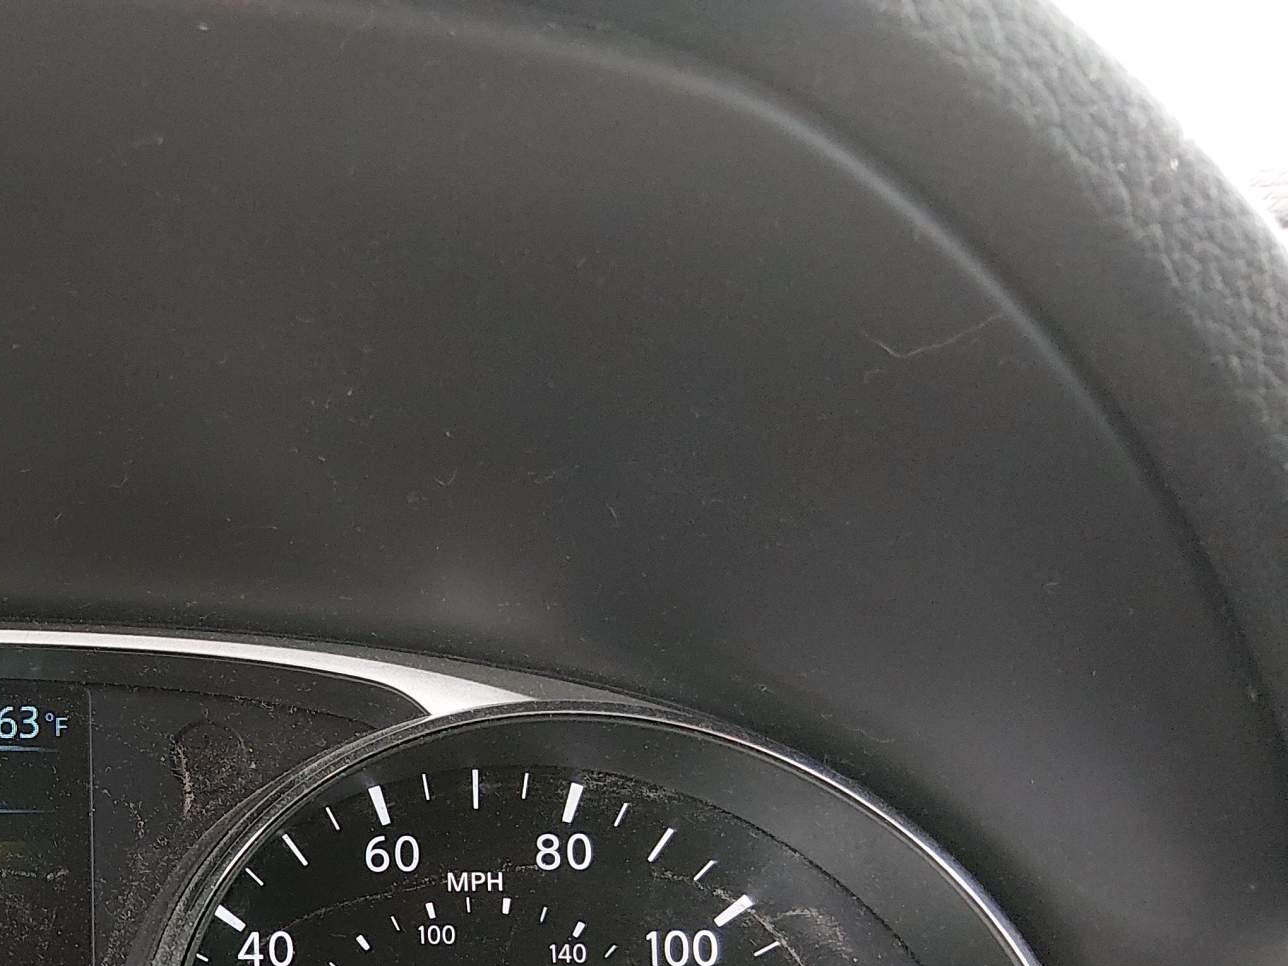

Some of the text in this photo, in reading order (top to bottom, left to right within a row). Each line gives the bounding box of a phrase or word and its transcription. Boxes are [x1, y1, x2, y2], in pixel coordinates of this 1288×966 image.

[365, 835, 420, 873] 60
[535, 833, 593, 871] 80
[447, 871, 504, 892] MPH
[418, 924, 456, 945] 100
[549, 943, 587, 964] 140
